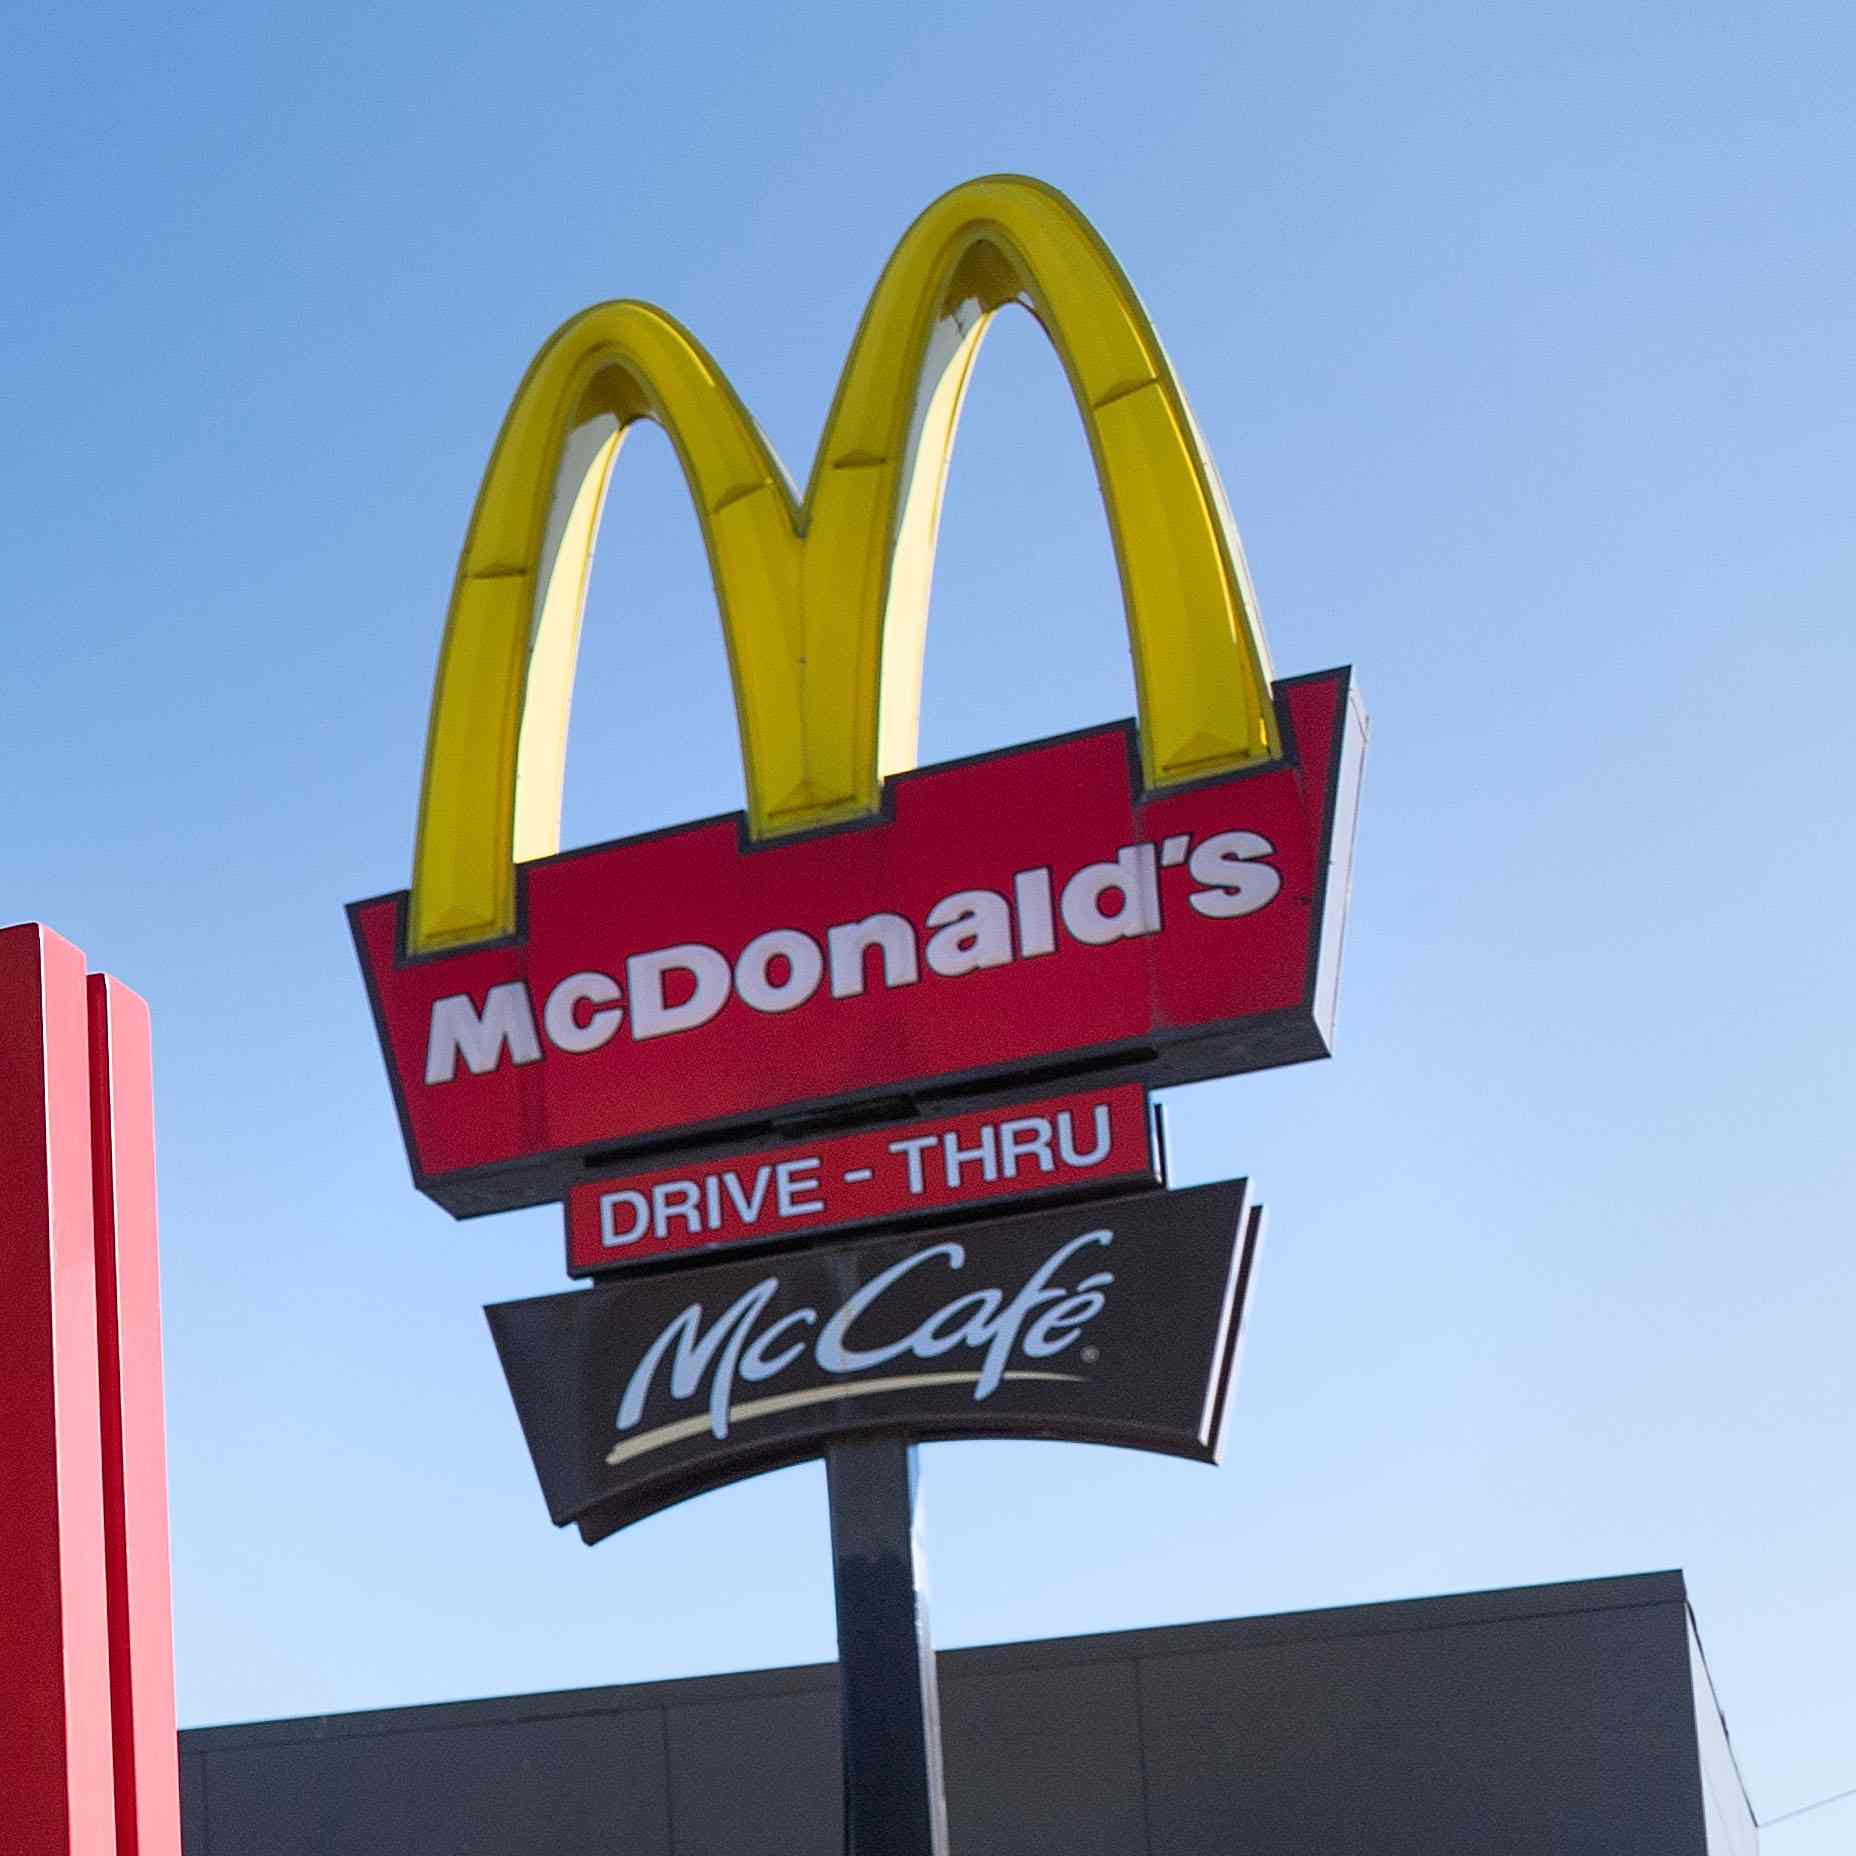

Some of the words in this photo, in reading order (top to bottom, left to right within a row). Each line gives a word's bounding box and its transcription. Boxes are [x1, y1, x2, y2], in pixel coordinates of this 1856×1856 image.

[423, 829, 1282, 1087] McDonald's
[599, 1156, 826, 1249] DRIVE
[889, 1103, 1113, 1195] THRU
[615, 1229, 1115, 1440] McCafé
